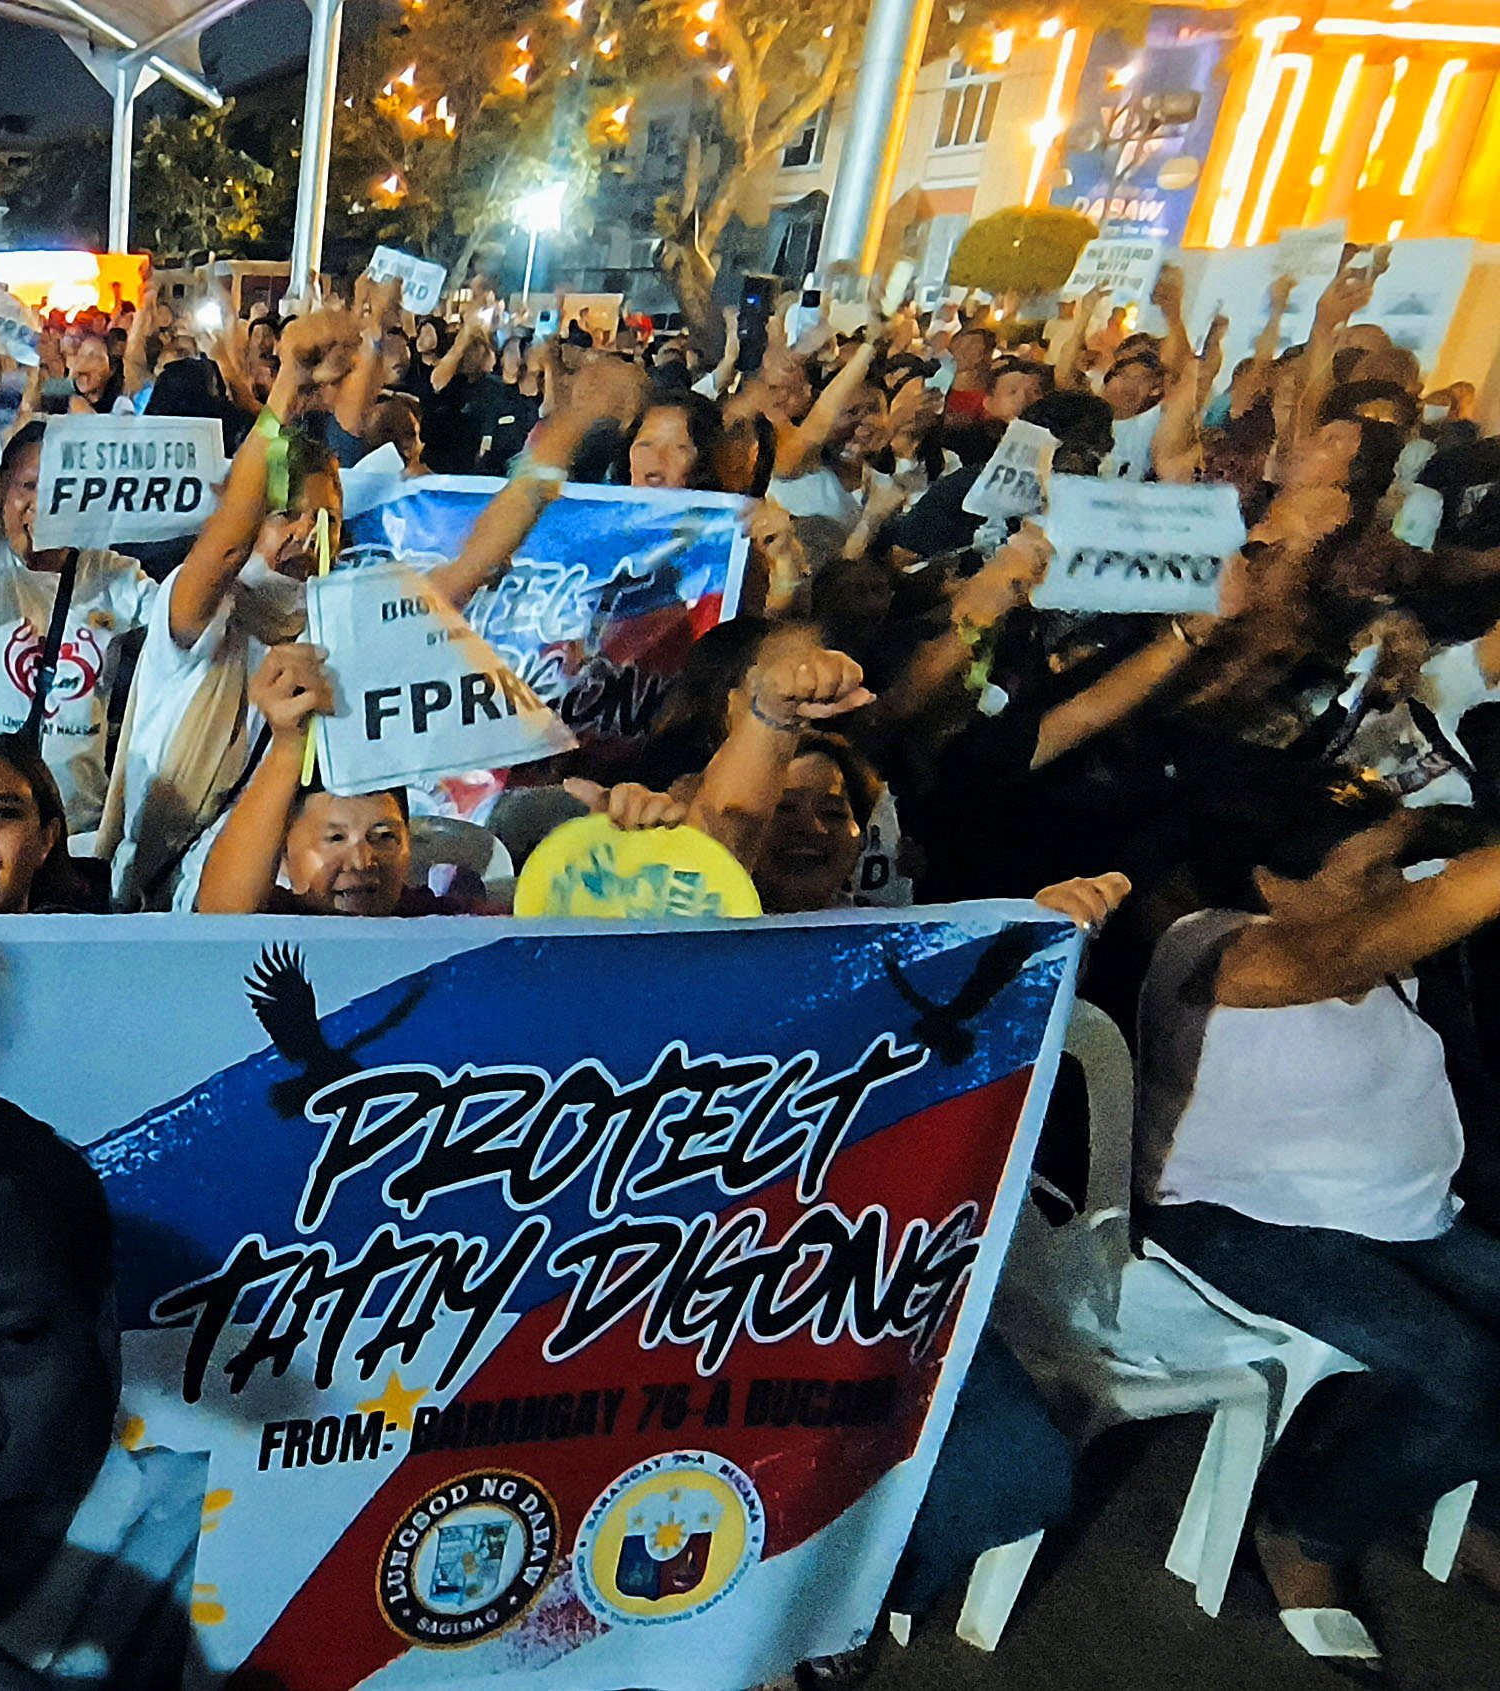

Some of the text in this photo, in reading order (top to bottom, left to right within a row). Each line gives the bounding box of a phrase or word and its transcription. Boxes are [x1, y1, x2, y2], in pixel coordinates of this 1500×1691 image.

[50, 476, 203, 515] FPRRD
[61, 441, 197, 471] WE STAND FOR
[295, 1032, 930, 1233] PROTECT
[150, 1201, 979, 1404] TATAY DIGONG
[257, 1410, 398, 1471] FROM:
[410, 1388, 626, 1454] BARANGAY
[387, 1478, 550, 1604] LUNGSOD NG DABAW
[416, 1608, 499, 1636] SAGISAG
